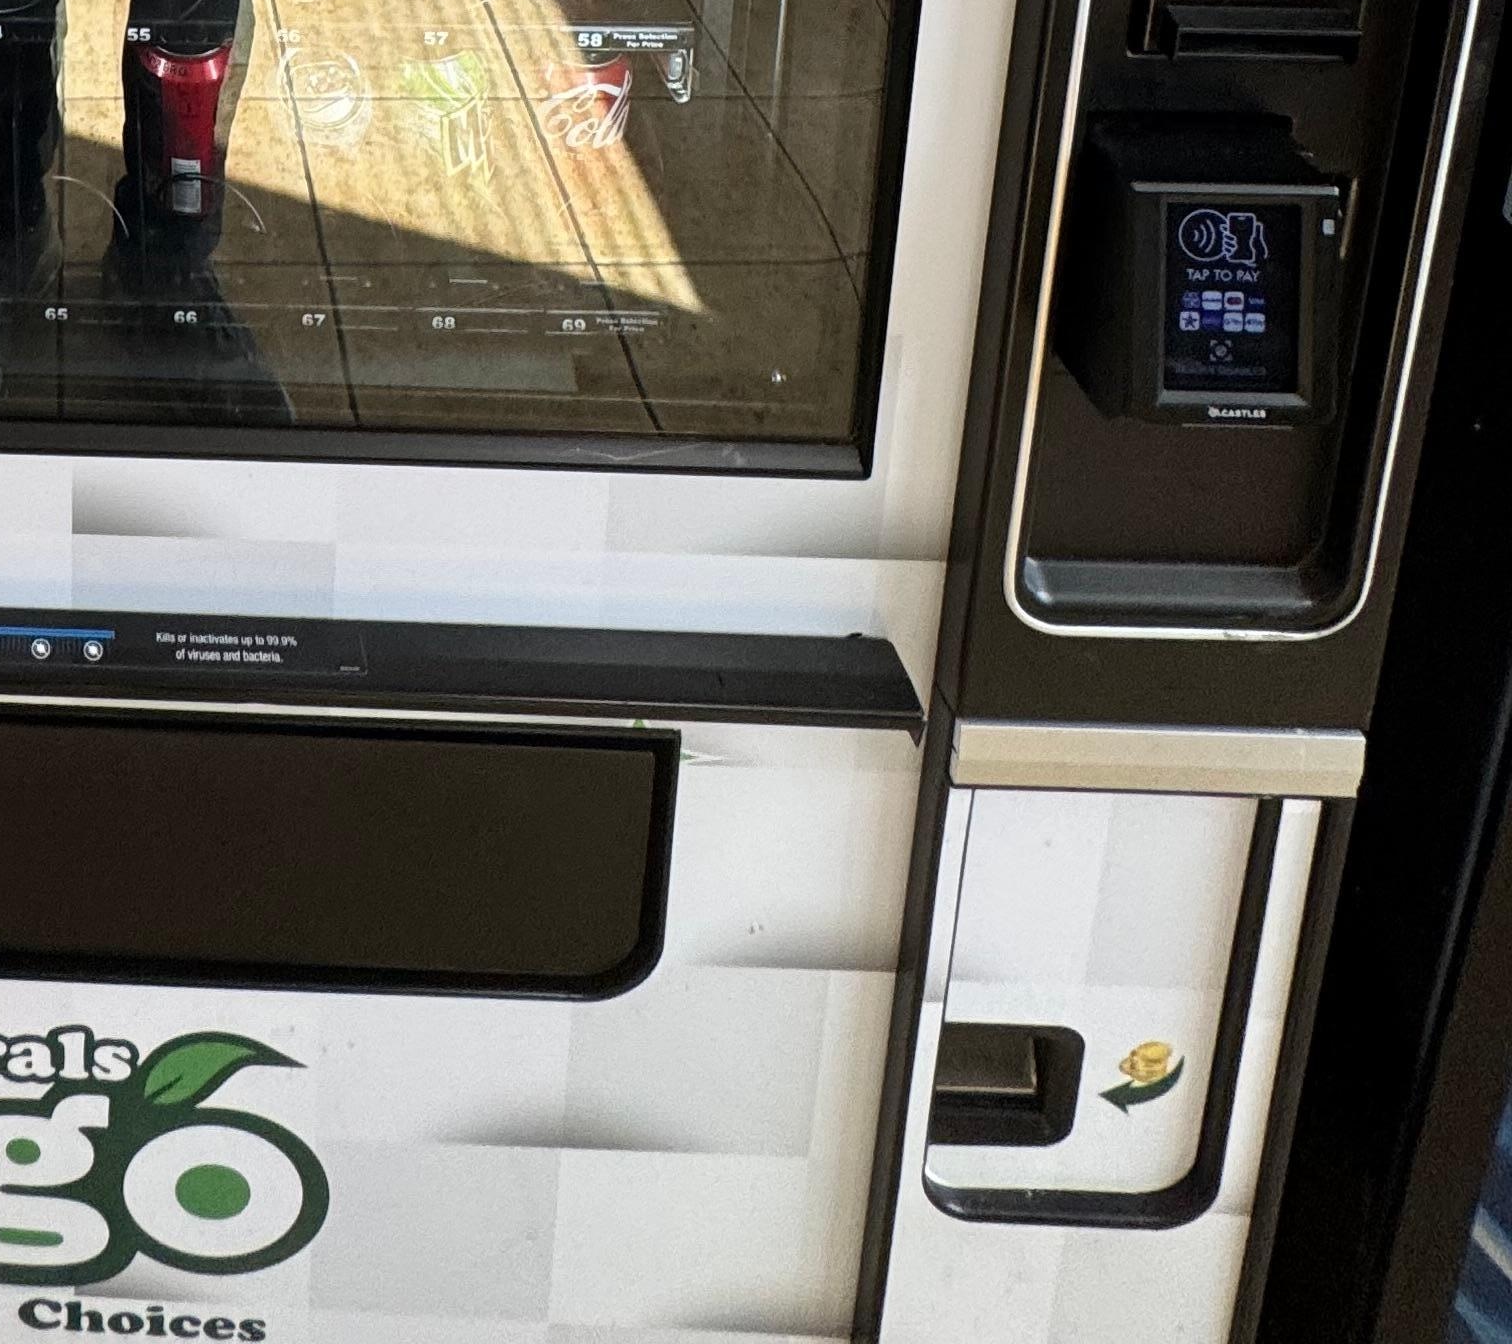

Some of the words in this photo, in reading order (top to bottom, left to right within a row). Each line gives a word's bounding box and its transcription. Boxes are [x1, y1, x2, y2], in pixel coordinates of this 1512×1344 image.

[127, 27, 151, 42] 55
[423, 31, 449, 46] 57
[577, 32, 603, 47] 58
[613, 32, 636, 41] Press
[638, 32, 678, 41] Selection
[1186, 268, 1210, 281] TAP
[1213, 268, 1232, 282] TO
[1236, 270, 1261, 282] PAY
[44, 307, 69, 322] 65
[173, 310, 198, 325] 66
[301, 313, 326, 328] 67
[431, 316, 456, 330] 68
[561, 318, 586, 331] 69
[156, 632, 176, 643] Kills
[178, 633, 187, 643] or
[189, 633, 239, 645] inactivates
[241, 636, 252, 646] up
[255, 635, 264, 645] to
[175, 648, 186, 660] of
[188, 648, 221, 661] viruses
[223, 650, 240, 662] and
[17, 1297, 267, 1342] Choices
